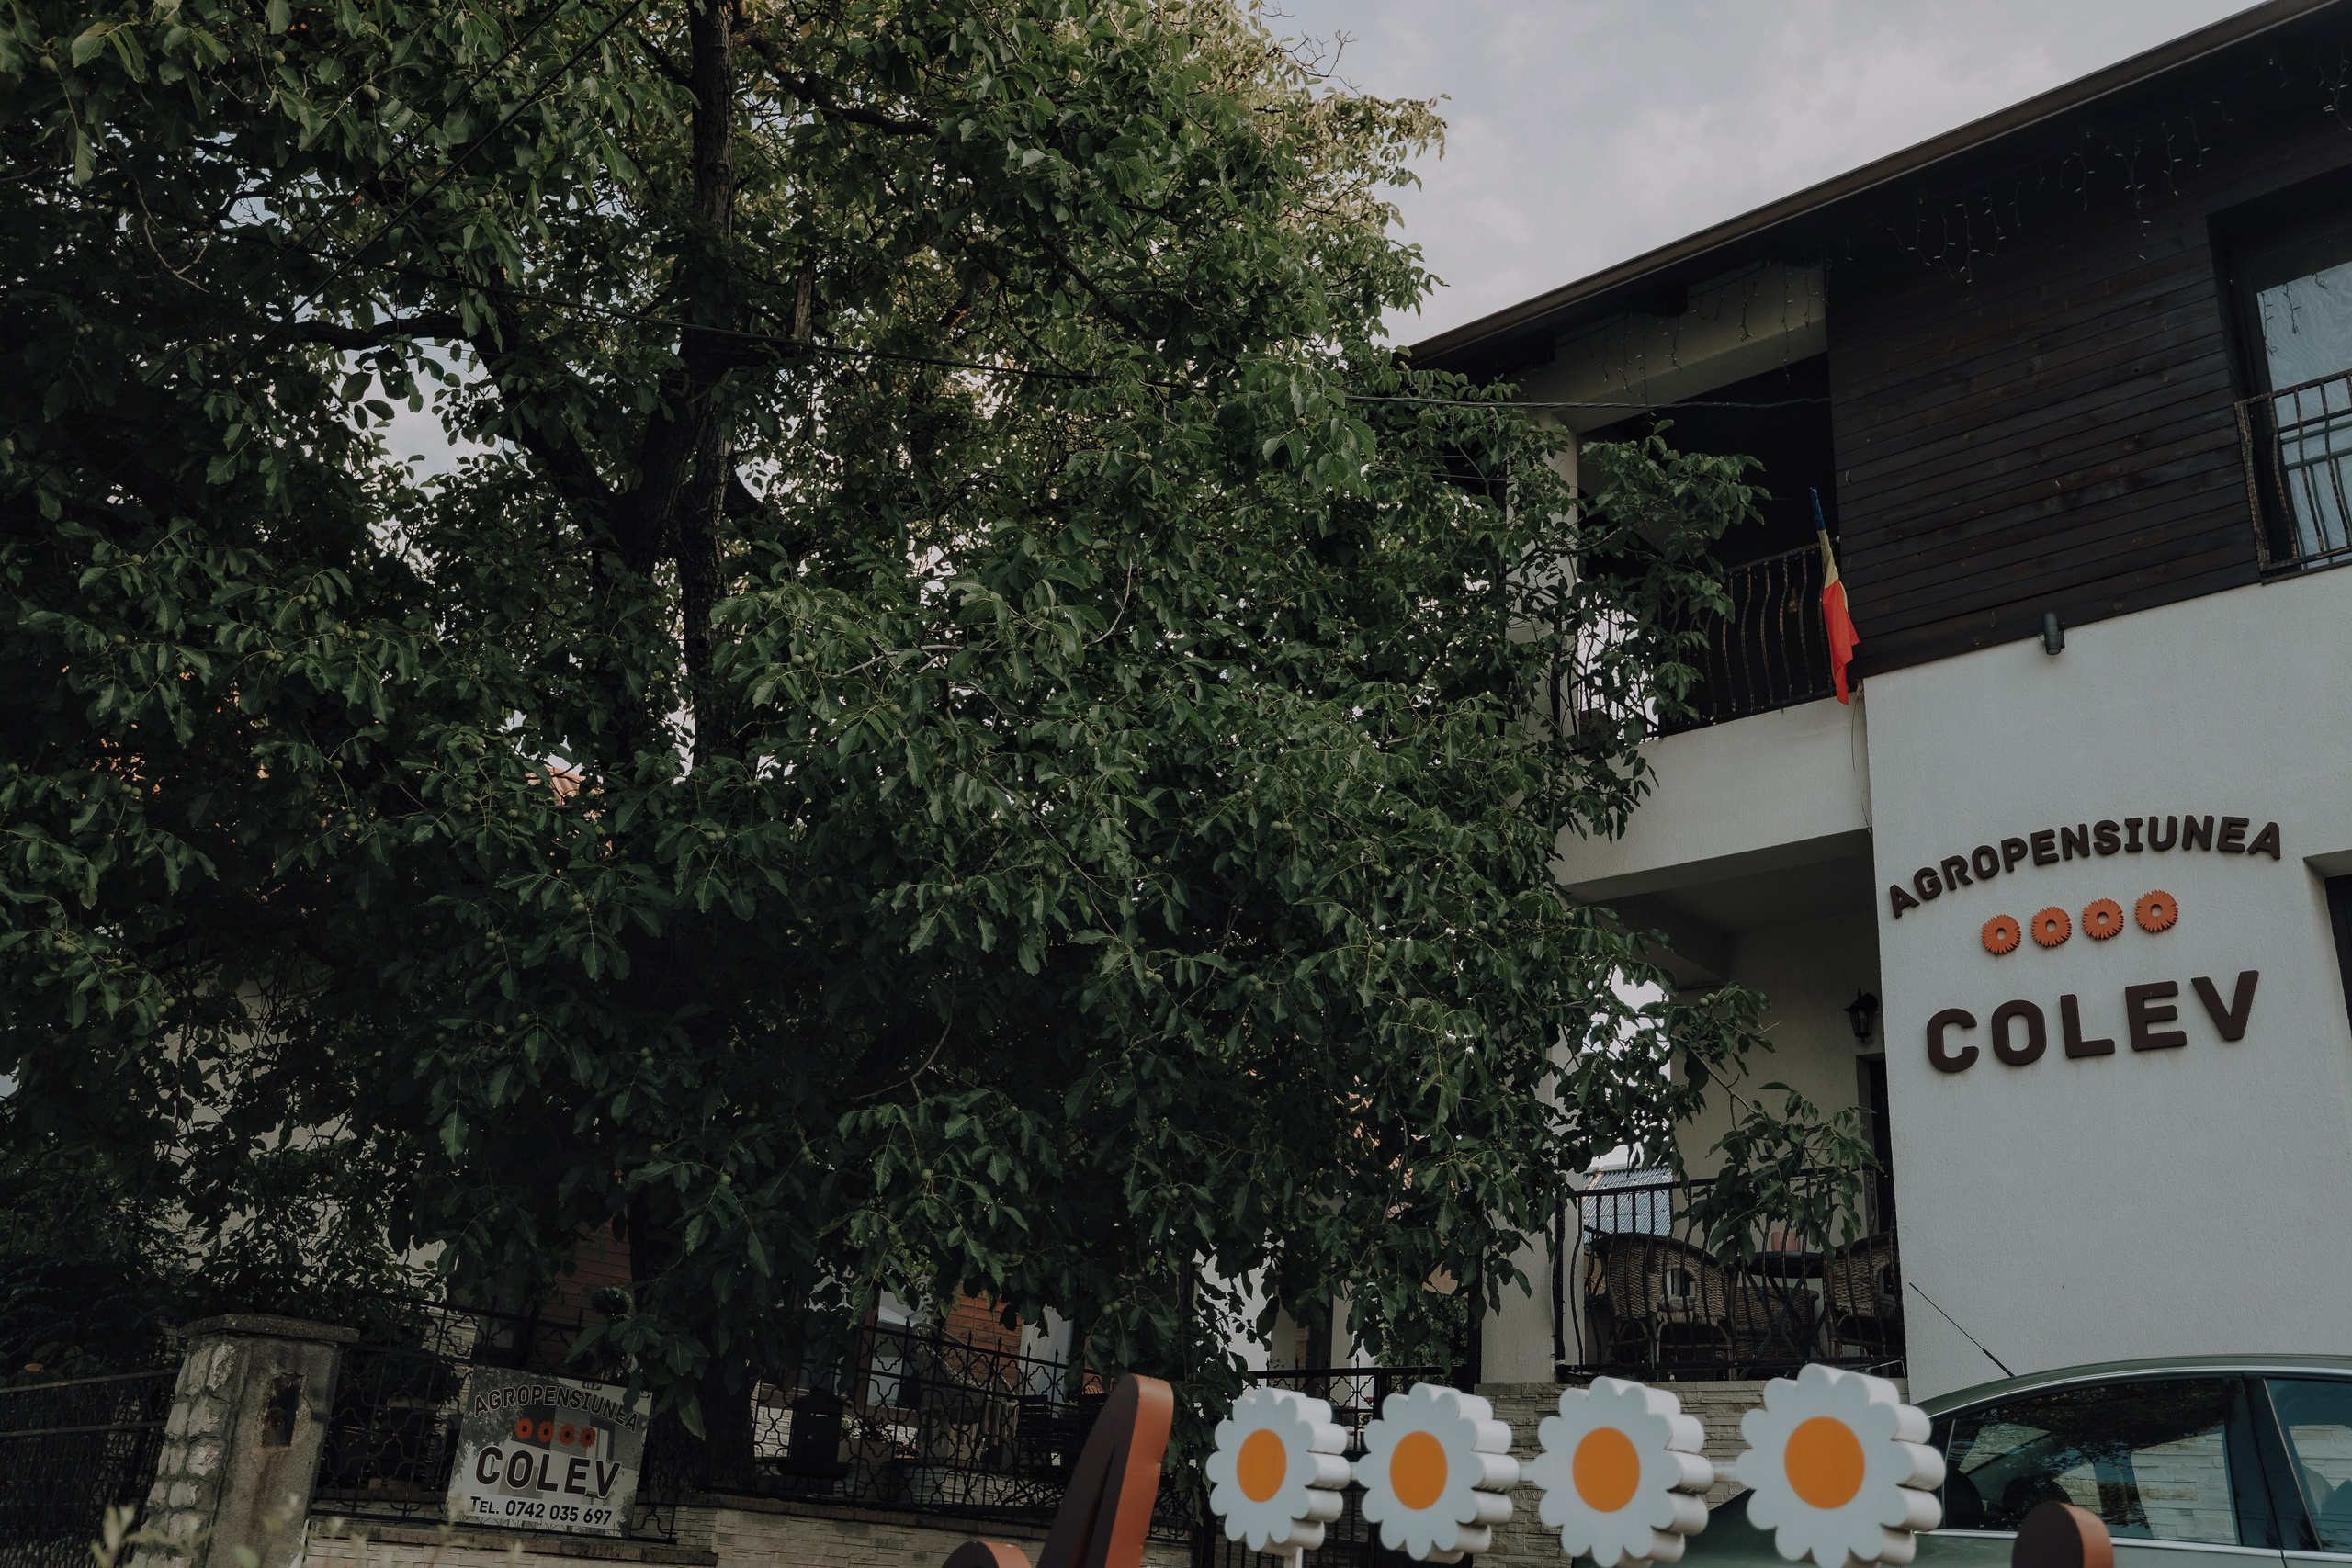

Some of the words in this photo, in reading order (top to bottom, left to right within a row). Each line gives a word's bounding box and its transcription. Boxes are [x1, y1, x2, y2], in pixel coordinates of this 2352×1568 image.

[1889, 814, 2281, 919] AGROPENSIUNEA
[1926, 969, 2259, 1073] COLEV
[474, 1384, 639, 1433] AGROPENSIUNEA
[475, 1445, 621, 1499] COLEV
[505, 1499, 546, 1519] 0742
[549, 1504, 579, 1521] 035
[582, 1507, 613, 1526] 697
